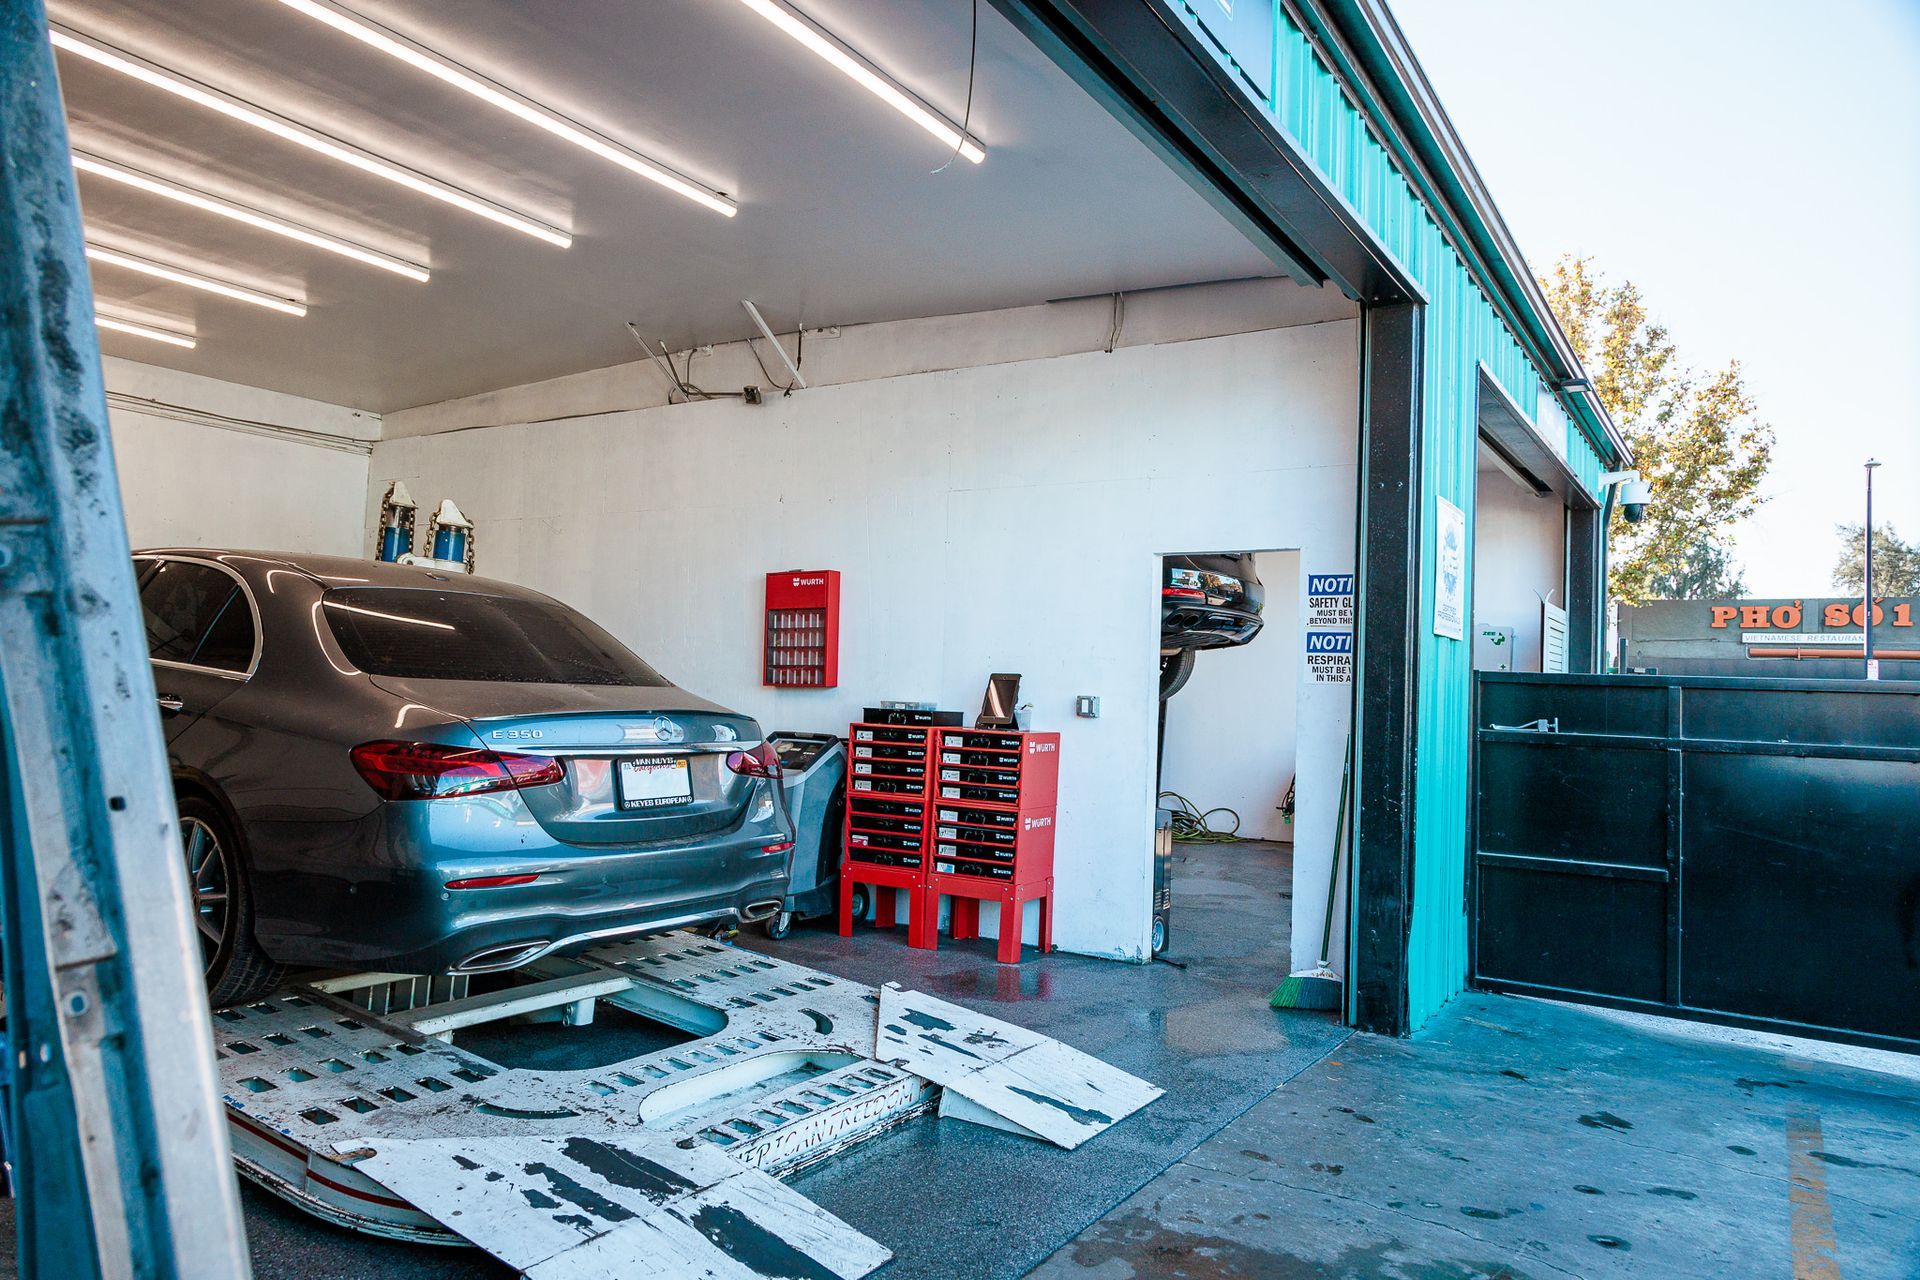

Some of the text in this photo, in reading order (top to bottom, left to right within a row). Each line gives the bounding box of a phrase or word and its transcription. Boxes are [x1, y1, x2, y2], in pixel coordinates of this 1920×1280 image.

[1311, 577, 1353, 592] NOTI
[1309, 597, 1352, 608] SAFETY GL
[1892, 603, 1914, 627] 1
[1310, 635, 1352, 650] NOTI
[1308, 655, 1351, 665] RESPIRA
[492, 730, 543, 739] E 350
